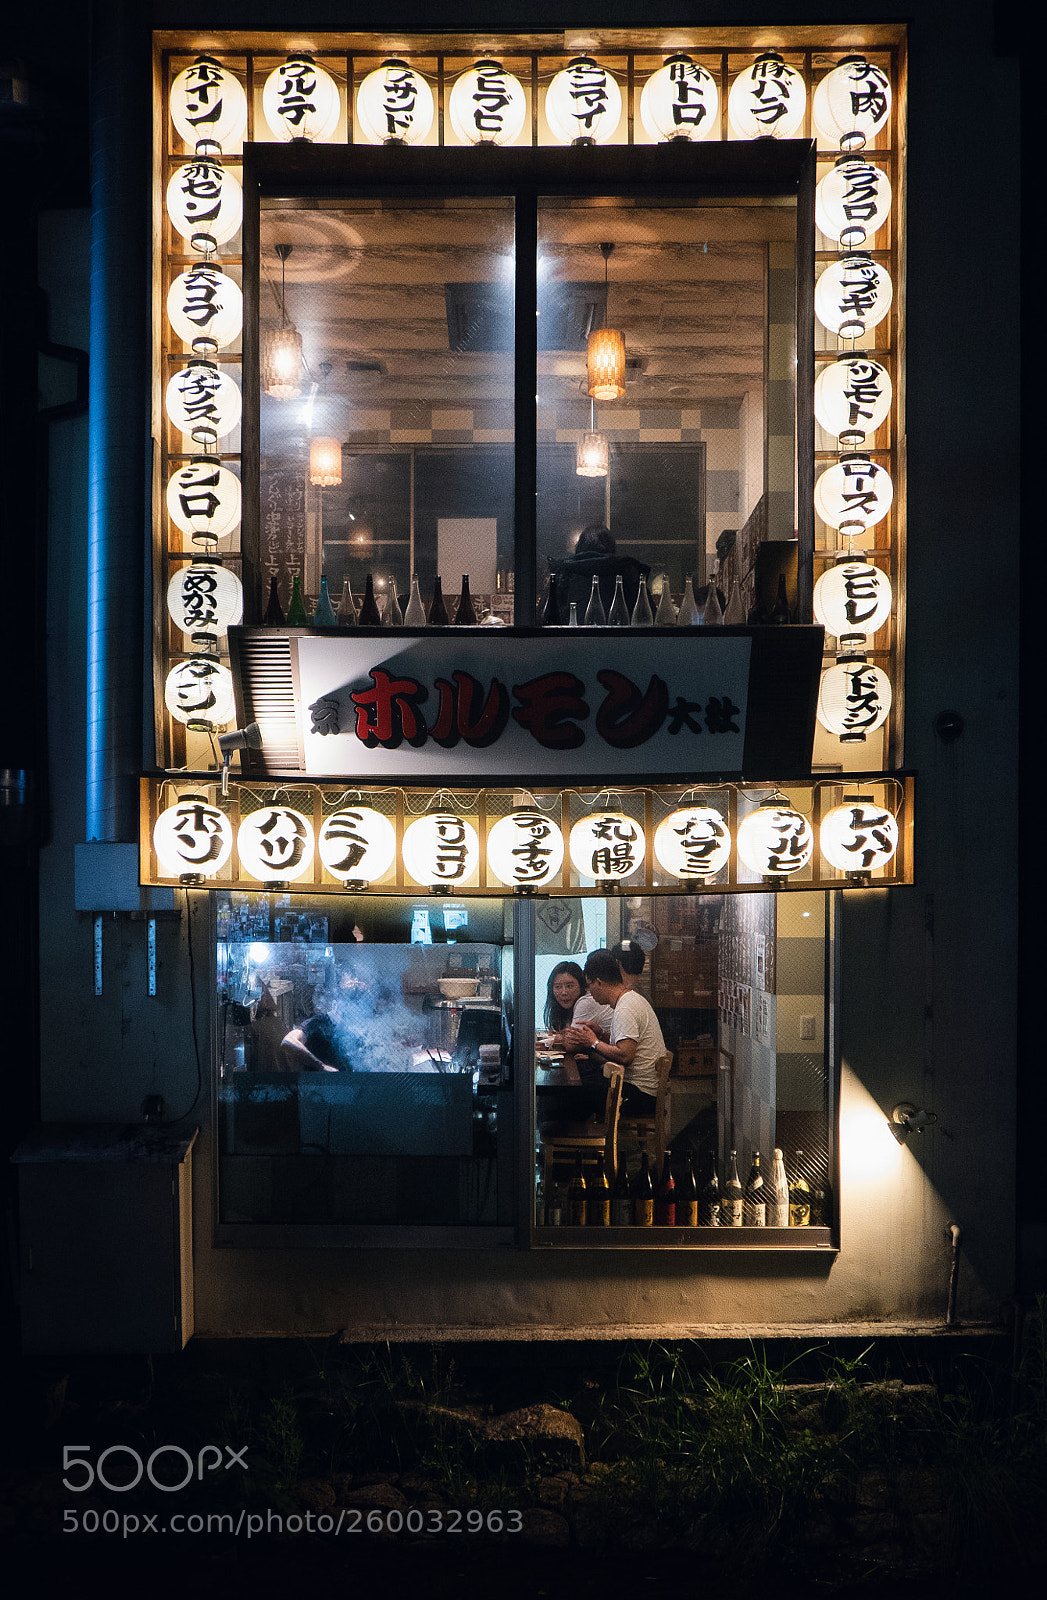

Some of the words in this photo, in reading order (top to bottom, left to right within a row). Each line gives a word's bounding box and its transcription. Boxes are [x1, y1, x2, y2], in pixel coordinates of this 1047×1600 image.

[277, 63, 317, 126] ウルテ
[669, 62, 711, 126] 豚トロ
[749, 60, 796, 124] 豚バラ
[838, 463, 880, 515] ロース
[841, 565, 880, 625] シビレ
[254, 810, 308, 870] ハツ
[511, 813, 554, 882] テッチャン
[591, 816, 638, 875] 丸腸
[766, 811, 810, 872] カルビ
[841, 808, 893, 868] レバー
